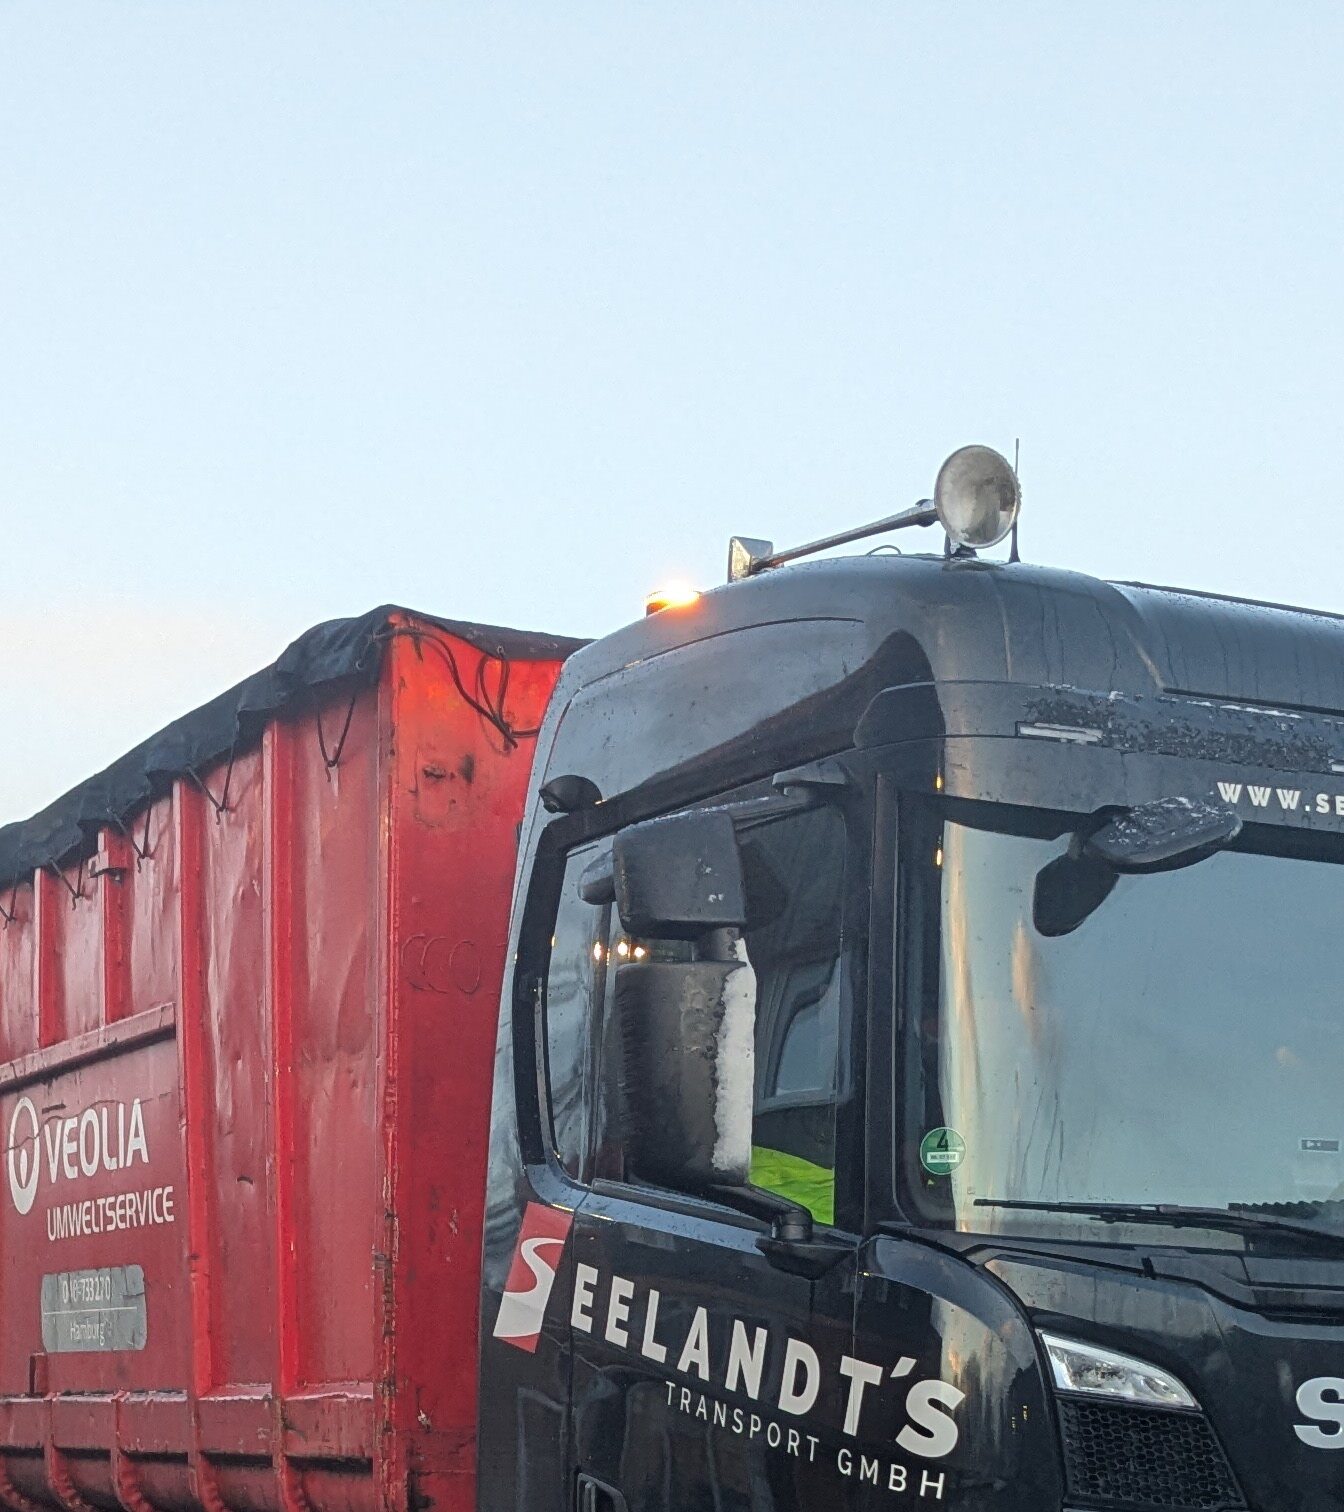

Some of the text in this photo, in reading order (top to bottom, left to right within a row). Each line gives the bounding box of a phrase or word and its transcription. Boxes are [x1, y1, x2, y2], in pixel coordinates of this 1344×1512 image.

[44, 1098, 149, 1184] VEOLIA
[937, 1130, 949, 1151] 4
[47, 1186, 175, 1241] UMWELTSERVICE
[665, 1381, 945, 1499] TRANSPORT GMBH
